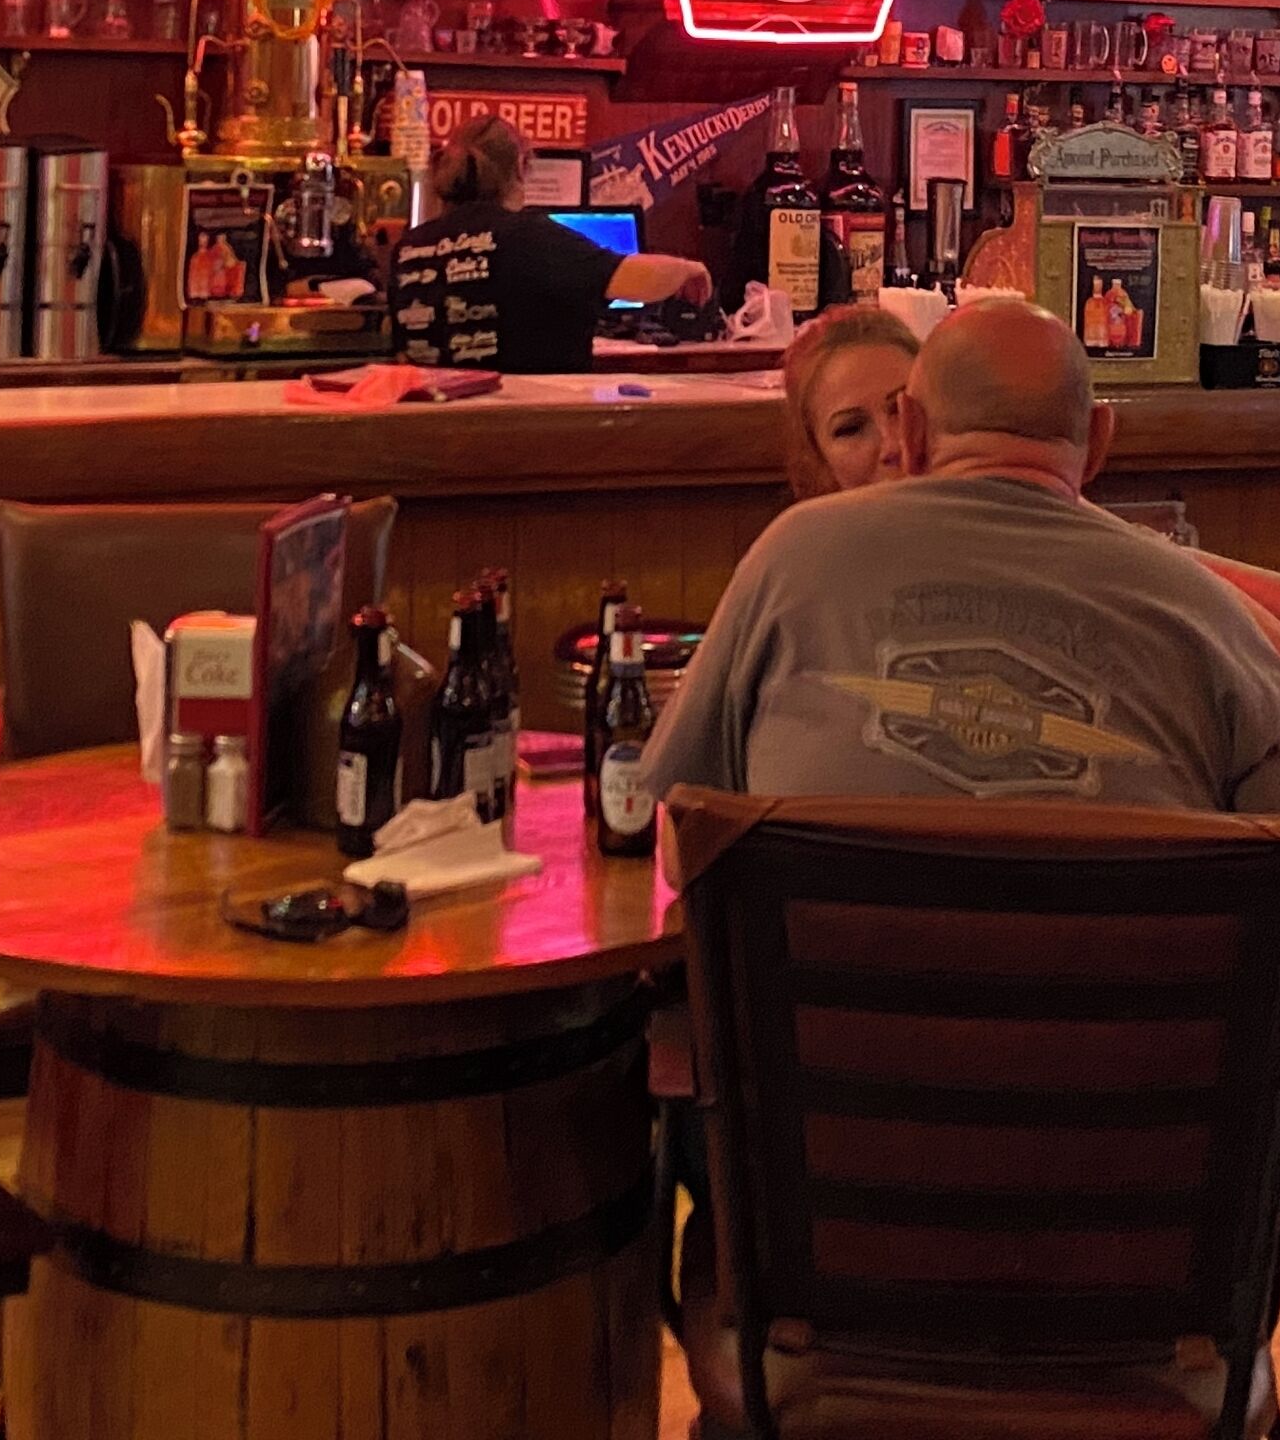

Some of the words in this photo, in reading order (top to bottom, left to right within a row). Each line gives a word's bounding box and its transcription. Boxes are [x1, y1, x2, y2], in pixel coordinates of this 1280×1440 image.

[497, 102, 574, 140] BEER
[636, 108, 734, 182] KENTUCKY
[725, 94, 771, 131] DERBY
[778, 212, 803, 224] OLD
[184, 660, 241, 687] Coke
